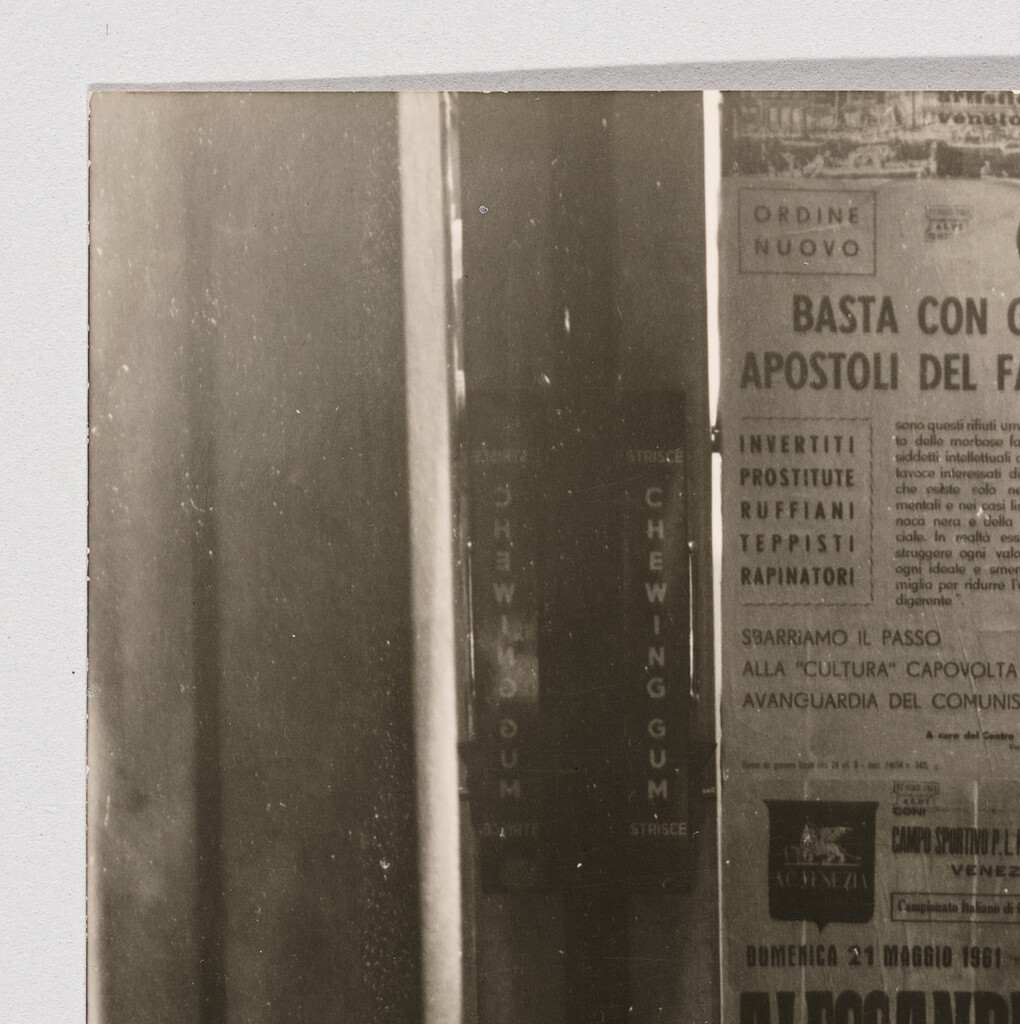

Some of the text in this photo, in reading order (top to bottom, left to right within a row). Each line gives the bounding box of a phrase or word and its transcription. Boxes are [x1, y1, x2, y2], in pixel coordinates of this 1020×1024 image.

[754, 205, 860, 224] ORDINE
[754, 238, 860, 258] NUOVO
[792, 294, 899, 335] BASTA
[917, 296, 988, 336] CON
[739, 351, 898, 391] APOSTOLI
[919, 352, 977, 392] DEL
[896, 422, 924, 431] sono
[928, 421, 963, 434] questi
[967, 420, 996, 431] rifiuti
[740, 434, 855, 454] INVERTITI
[896, 437, 907, 446] to
[915, 436, 943, 446] delle
[626, 450, 684, 464] STRISCE
[945, 452, 1011, 463] intellettuali
[740, 468, 855, 488] PROSTITUTE
[896, 469, 935, 479] tavoce
[941, 468, 1001, 479] interessati
[1010, 468, 1020, 479] di
[896, 484, 916, 494] che
[972, 484, 996, 495] solo
[740, 500, 855, 520] RUFFIANI
[896, 500, 940, 511] mentali
[946, 503, 953, 511] e
[959, 500, 976, 511] nei
[896, 518, 925, 526] naca
[934, 518, 960, 526] nera
[983, 516, 1012, 526] della
[740, 534, 855, 553] TEPPISTI
[896, 549, 952, 561] struggere
[960, 548, 985, 560] ogni
[740, 566, 855, 586] RAPINATORI
[896, 564, 921, 576] ogni
[939, 582, 958, 592] per
[965, 579, 1005, 590] ridurre
[645, 486, 668, 800] CHEWING GUM
[741, 629, 942, 646] SBARRIAMO IL PASSO
[742, 662, 785, 678] ALLA
[906, 661, 1018, 679] CAPOVOLTA
[742, 692, 878, 710] AVANGUARDIA
[889, 693, 922, 710] DEL
[926, 732, 934, 740] A
[964, 732, 980, 740] del
[630, 822, 688, 836] STRISCE
[892, 826, 932, 854] CAMPO
[935, 826, 988, 856] SPORTIVO
[898, 899, 958, 915] Campionato
[961, 900, 1000, 914] Italiano
[1003, 902, 1014, 914] di
[746, 944, 838, 967] DOMENICA
[848, 944, 874, 966] 21
[883, 945, 952, 968] MAGGIO
[963, 946, 1002, 968] 1961
